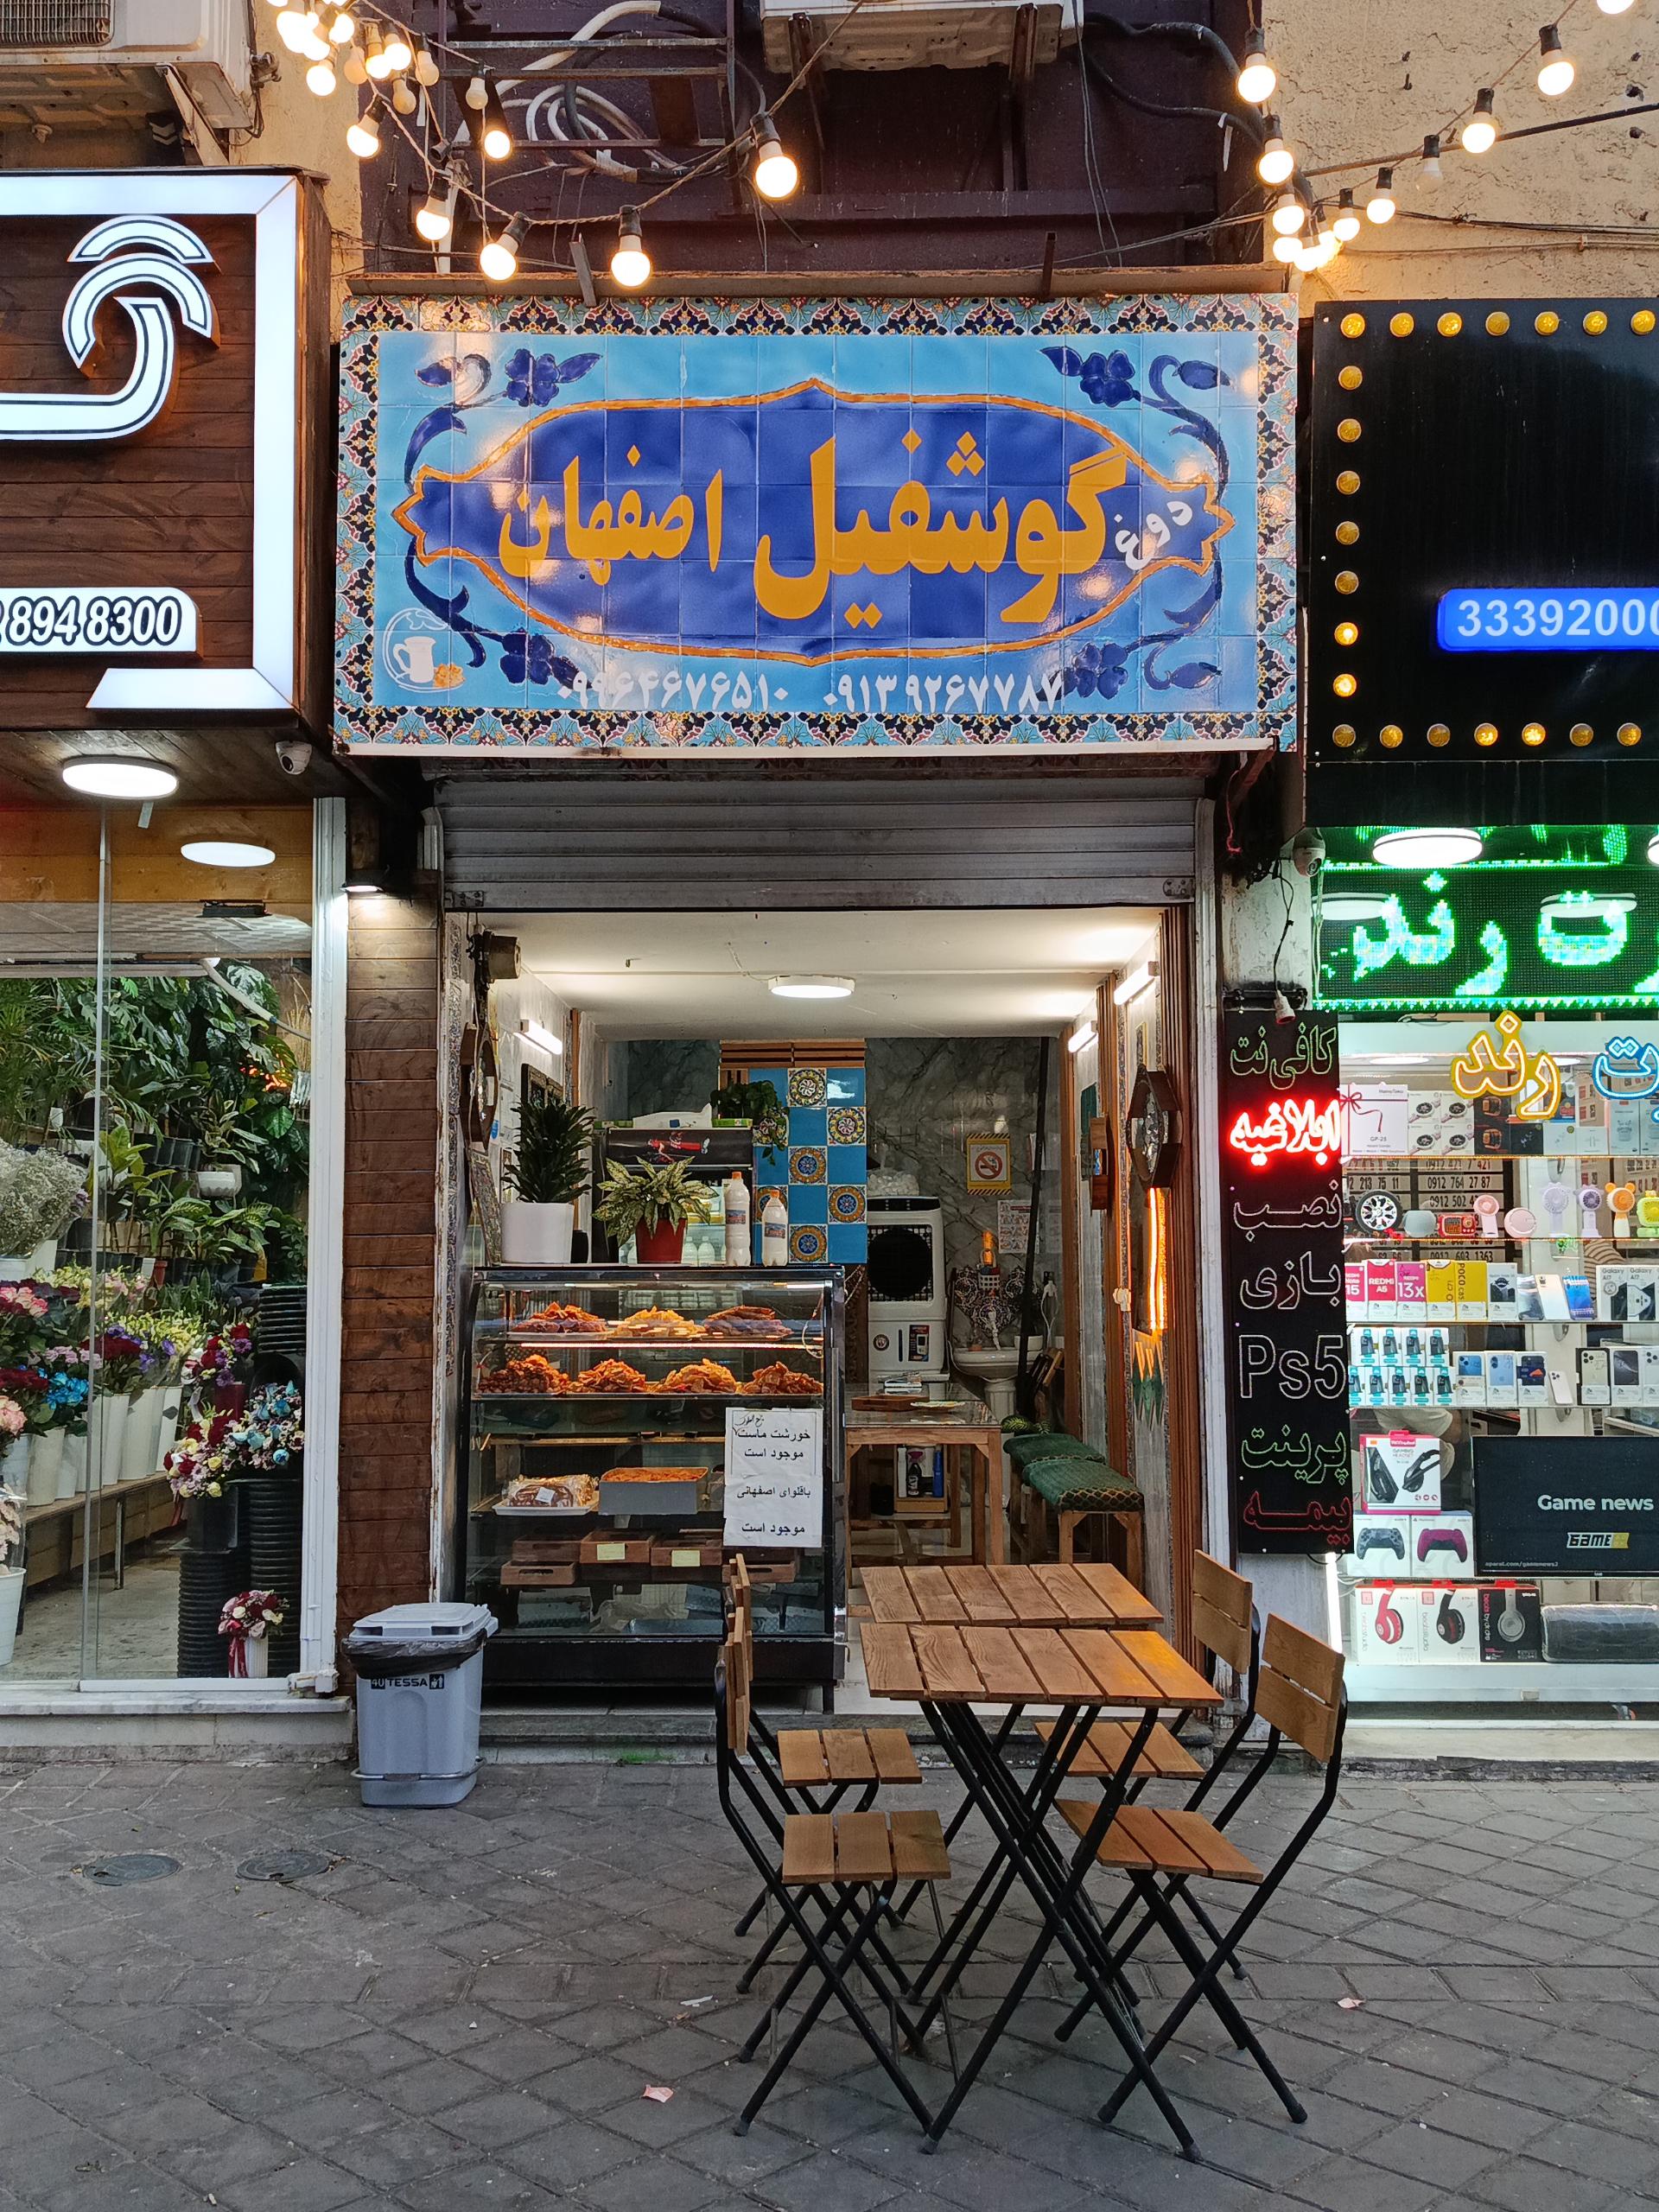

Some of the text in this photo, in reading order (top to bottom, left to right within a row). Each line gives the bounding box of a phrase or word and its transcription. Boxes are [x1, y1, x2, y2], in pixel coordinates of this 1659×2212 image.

[498, 428, 1193, 629] دوغ گوشفیل اصفهان
[1230, 1021, 1338, 1090] کافی نت
[1454, 1013, 1560, 1120] رند
[1427, 1176, 1446, 1189] 0912
[1469, 1176, 1478, 1189] 27
[1481, 1176, 1491, 1189] 87
[1233, 1179, 1343, 1243] نصب
[1429, 1195, 1449, 1207] 0912
[1452, 1195, 1466, 1207] 502
[1239, 1250, 1341, 1310] بازی
[1458, 1262, 1466, 1287] POCO
[1238, 1334, 1347, 1400] Ps5
[737, 1427, 810, 1441] خورشت ماست
[744, 1447, 804, 1460] موجود است
[1241, 1424, 1349, 1485] پرینت
[736, 1484, 811, 1498] باقلوای اصفهانی
[1537, 1494, 1655, 1510] Game news
[741, 1522, 805, 1536] موجود است
[1243, 1490, 1352, 1545] بیمه
[386, 1677, 429, 1688] TESSA
